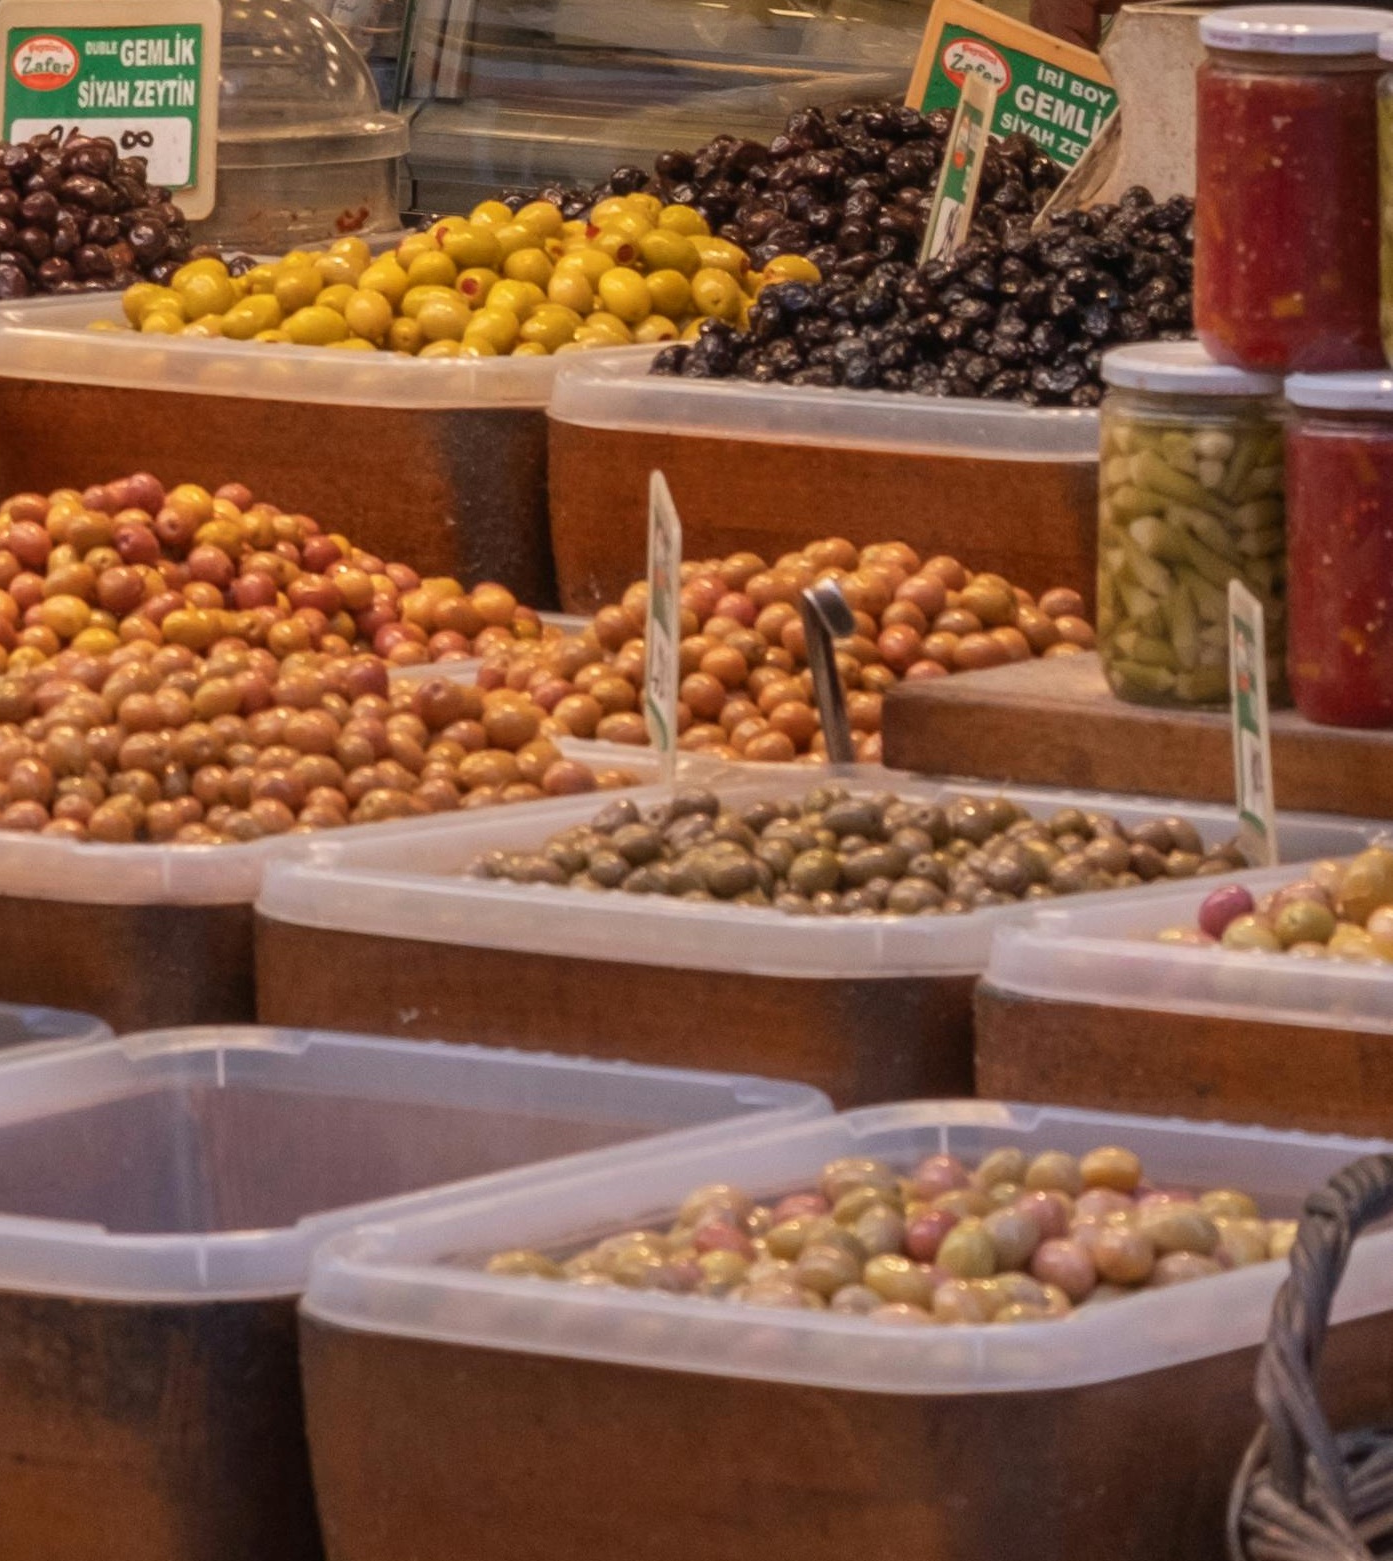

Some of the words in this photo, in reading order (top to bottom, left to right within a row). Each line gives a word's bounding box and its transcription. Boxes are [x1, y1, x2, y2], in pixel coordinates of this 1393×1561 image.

[21, 56, 72, 75] Zafer
[85, 41, 118, 55] DUBLE
[120, 32, 195, 67] GEMLİK
[78, 74, 130, 108] SİYAH
[133, 73, 195, 107] ZEYTİN
[1036, 63, 1065, 89] İRİ
[1069, 80, 1112, 107] BOY
[1000, 112, 1056, 147] SİYAH
[1014, 84, 1105, 140] GEMLİ
